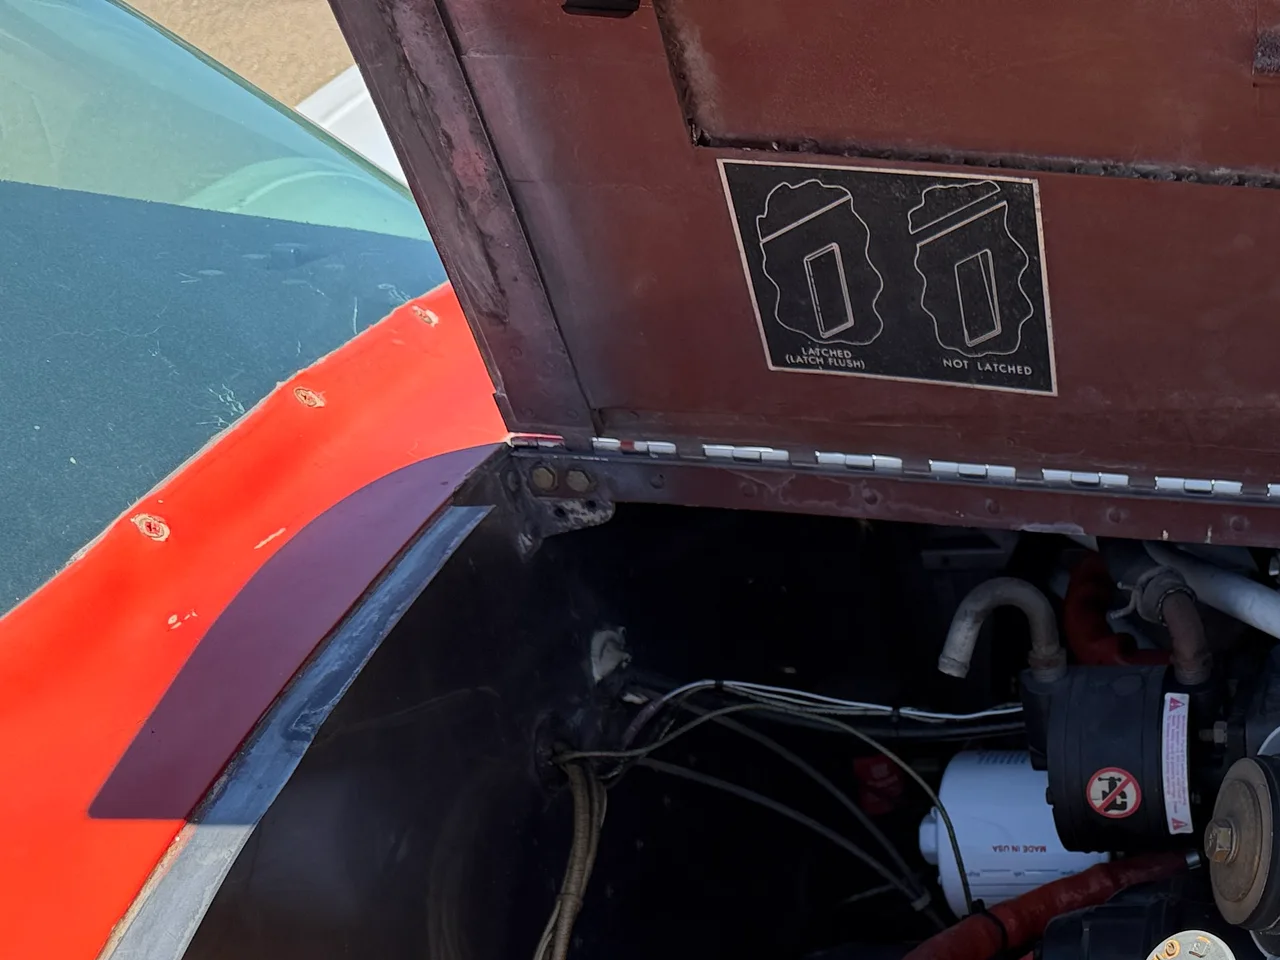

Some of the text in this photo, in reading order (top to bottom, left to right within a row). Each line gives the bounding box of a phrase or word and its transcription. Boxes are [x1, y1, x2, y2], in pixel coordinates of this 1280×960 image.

[801, 347, 852, 359] LATCHED
[785, 354, 866, 370] (LATCH FLUSH)
[943, 358, 1033, 376] NOT LATCHED
[992, 844, 1047, 853] MADE IN USA
